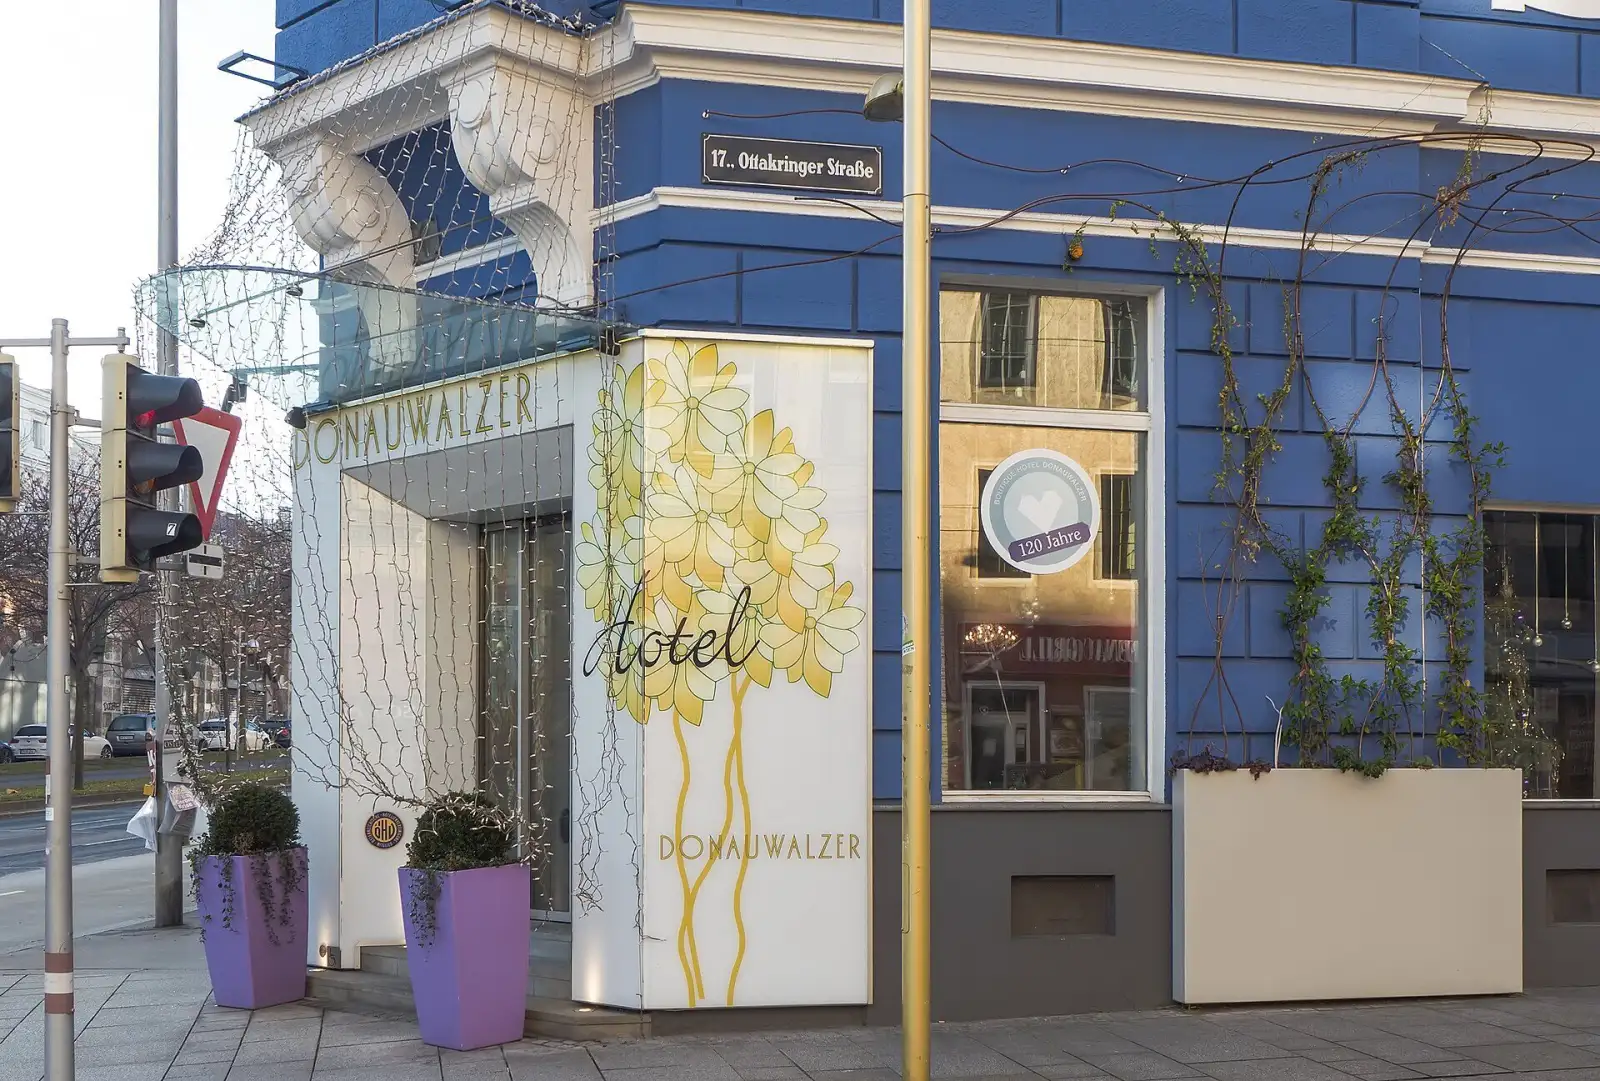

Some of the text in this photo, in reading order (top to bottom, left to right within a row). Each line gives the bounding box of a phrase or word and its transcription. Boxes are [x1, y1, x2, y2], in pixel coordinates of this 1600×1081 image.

[738, 151, 824, 177] Ottakringer
[827, 157, 874, 179] Straße
[293, 372, 533, 471] DONAUWALZER
[994, 461, 1087, 505] BOUTIQUE HOTEL DONAUWALZER
[1018, 530, 1082, 557] 120 Jahre
[583, 569, 761, 677] Hotel
[659, 833, 862, 860] DONAUWALZER
